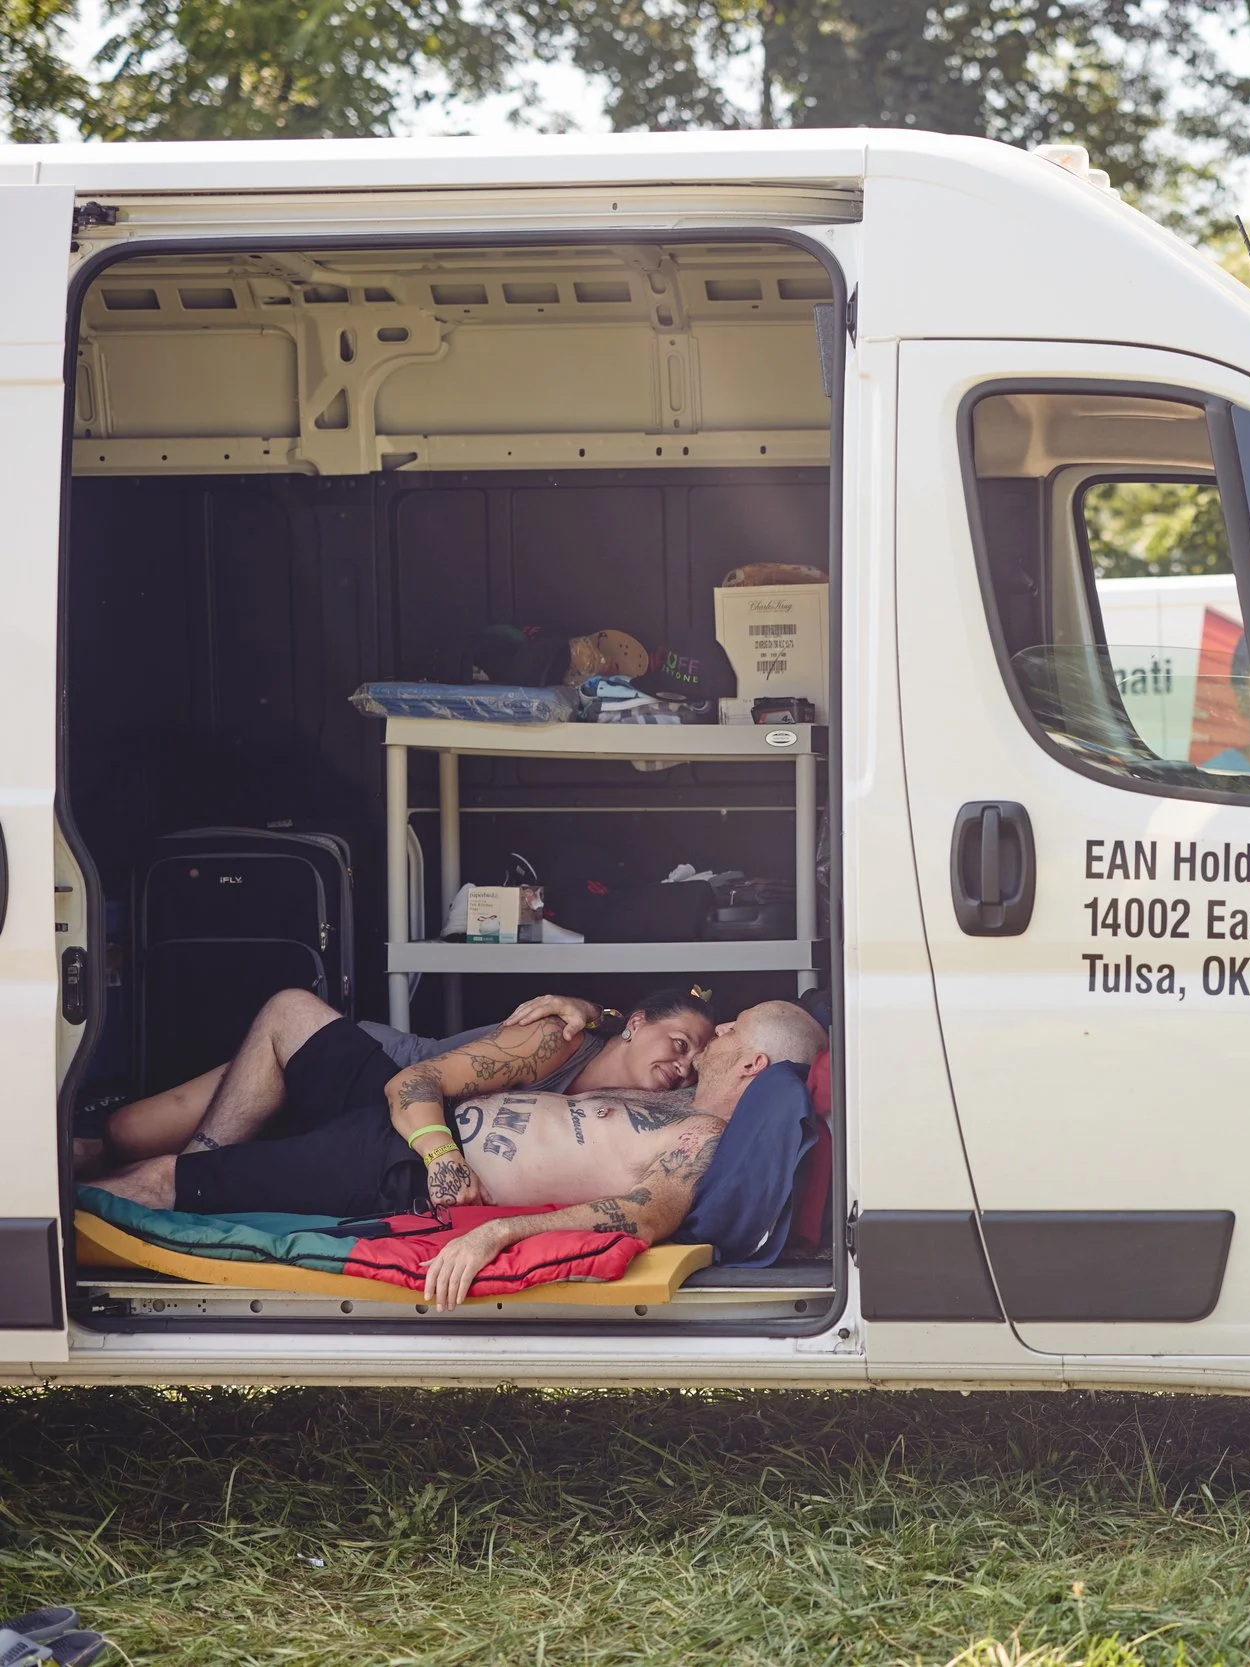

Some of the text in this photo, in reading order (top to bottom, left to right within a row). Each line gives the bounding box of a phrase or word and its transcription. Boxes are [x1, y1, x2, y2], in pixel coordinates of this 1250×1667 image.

[1085, 839, 1158, 881] EAN
[1083, 897, 1191, 939] 14002
[1082, 953, 1186, 1000] Tulsa,
[1202, 955, 1250, 997] OK
[483, 1092, 541, 1161] ING
